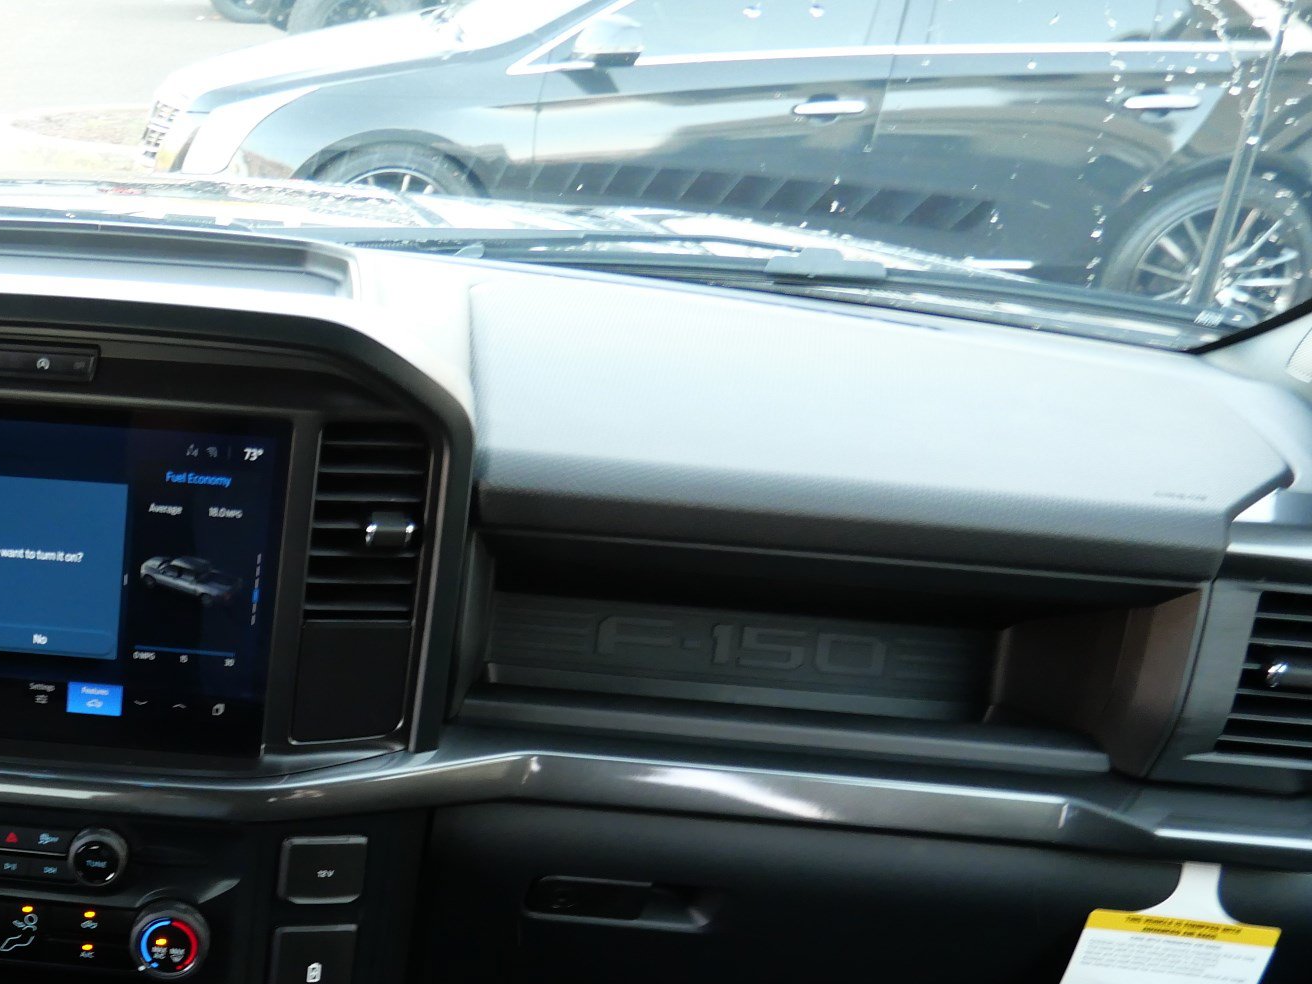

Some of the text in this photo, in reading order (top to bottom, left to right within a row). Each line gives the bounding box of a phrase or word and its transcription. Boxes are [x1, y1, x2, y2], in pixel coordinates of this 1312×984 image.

[165, 470, 233, 488] Fuel Economy
[148, 502, 184, 516] Average
[0, 548, 25, 558] want
[25, 549, 36, 559] to
[36, 550, 56, 560] turn
[56, 551, 65, 561] it
[65, 552, 84, 562] on?
[32, 633, 48, 645] No
[595, 615, 888, 676] F-150
